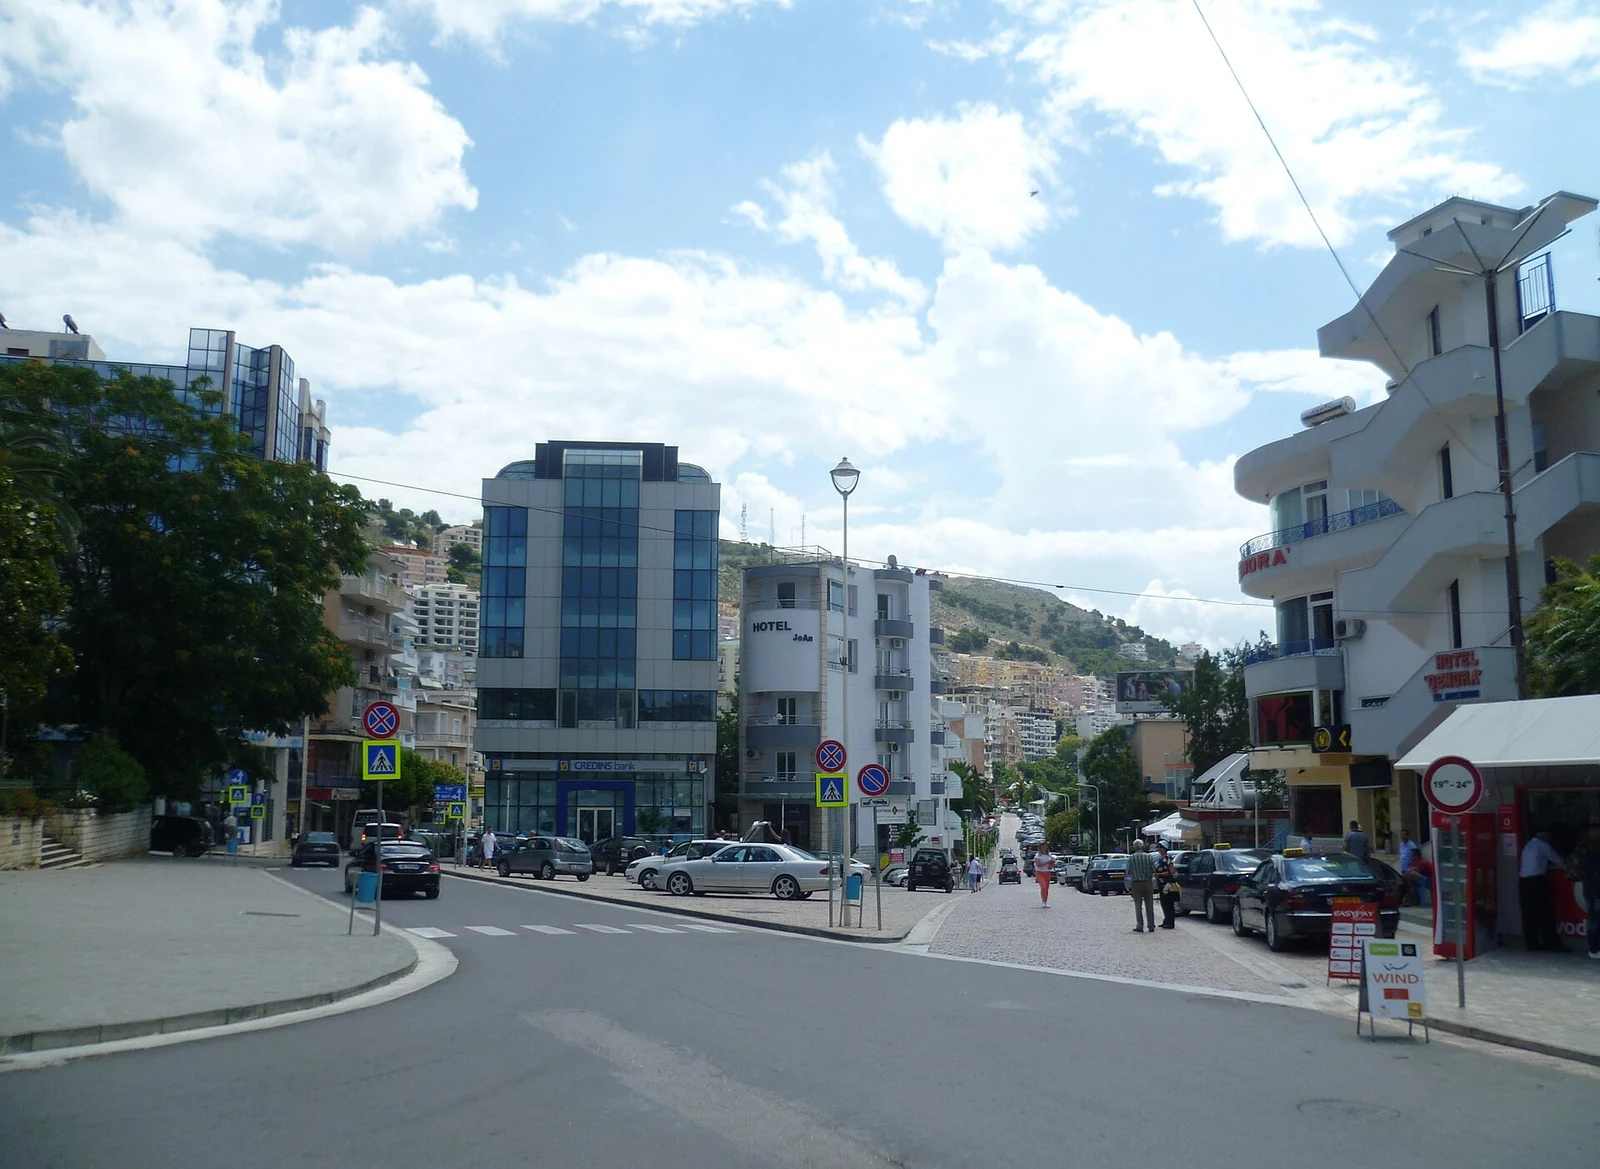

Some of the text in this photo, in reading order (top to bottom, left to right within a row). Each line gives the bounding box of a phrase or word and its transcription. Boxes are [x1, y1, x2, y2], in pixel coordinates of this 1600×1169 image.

[753, 621, 792, 632] HOTEL
[793, 634, 813, 642] JoAn
[1435, 651, 1479, 669] HOTEL
[574, 761, 635, 770] CREDINS bank
[1372, 973, 1419, 984] WIND
